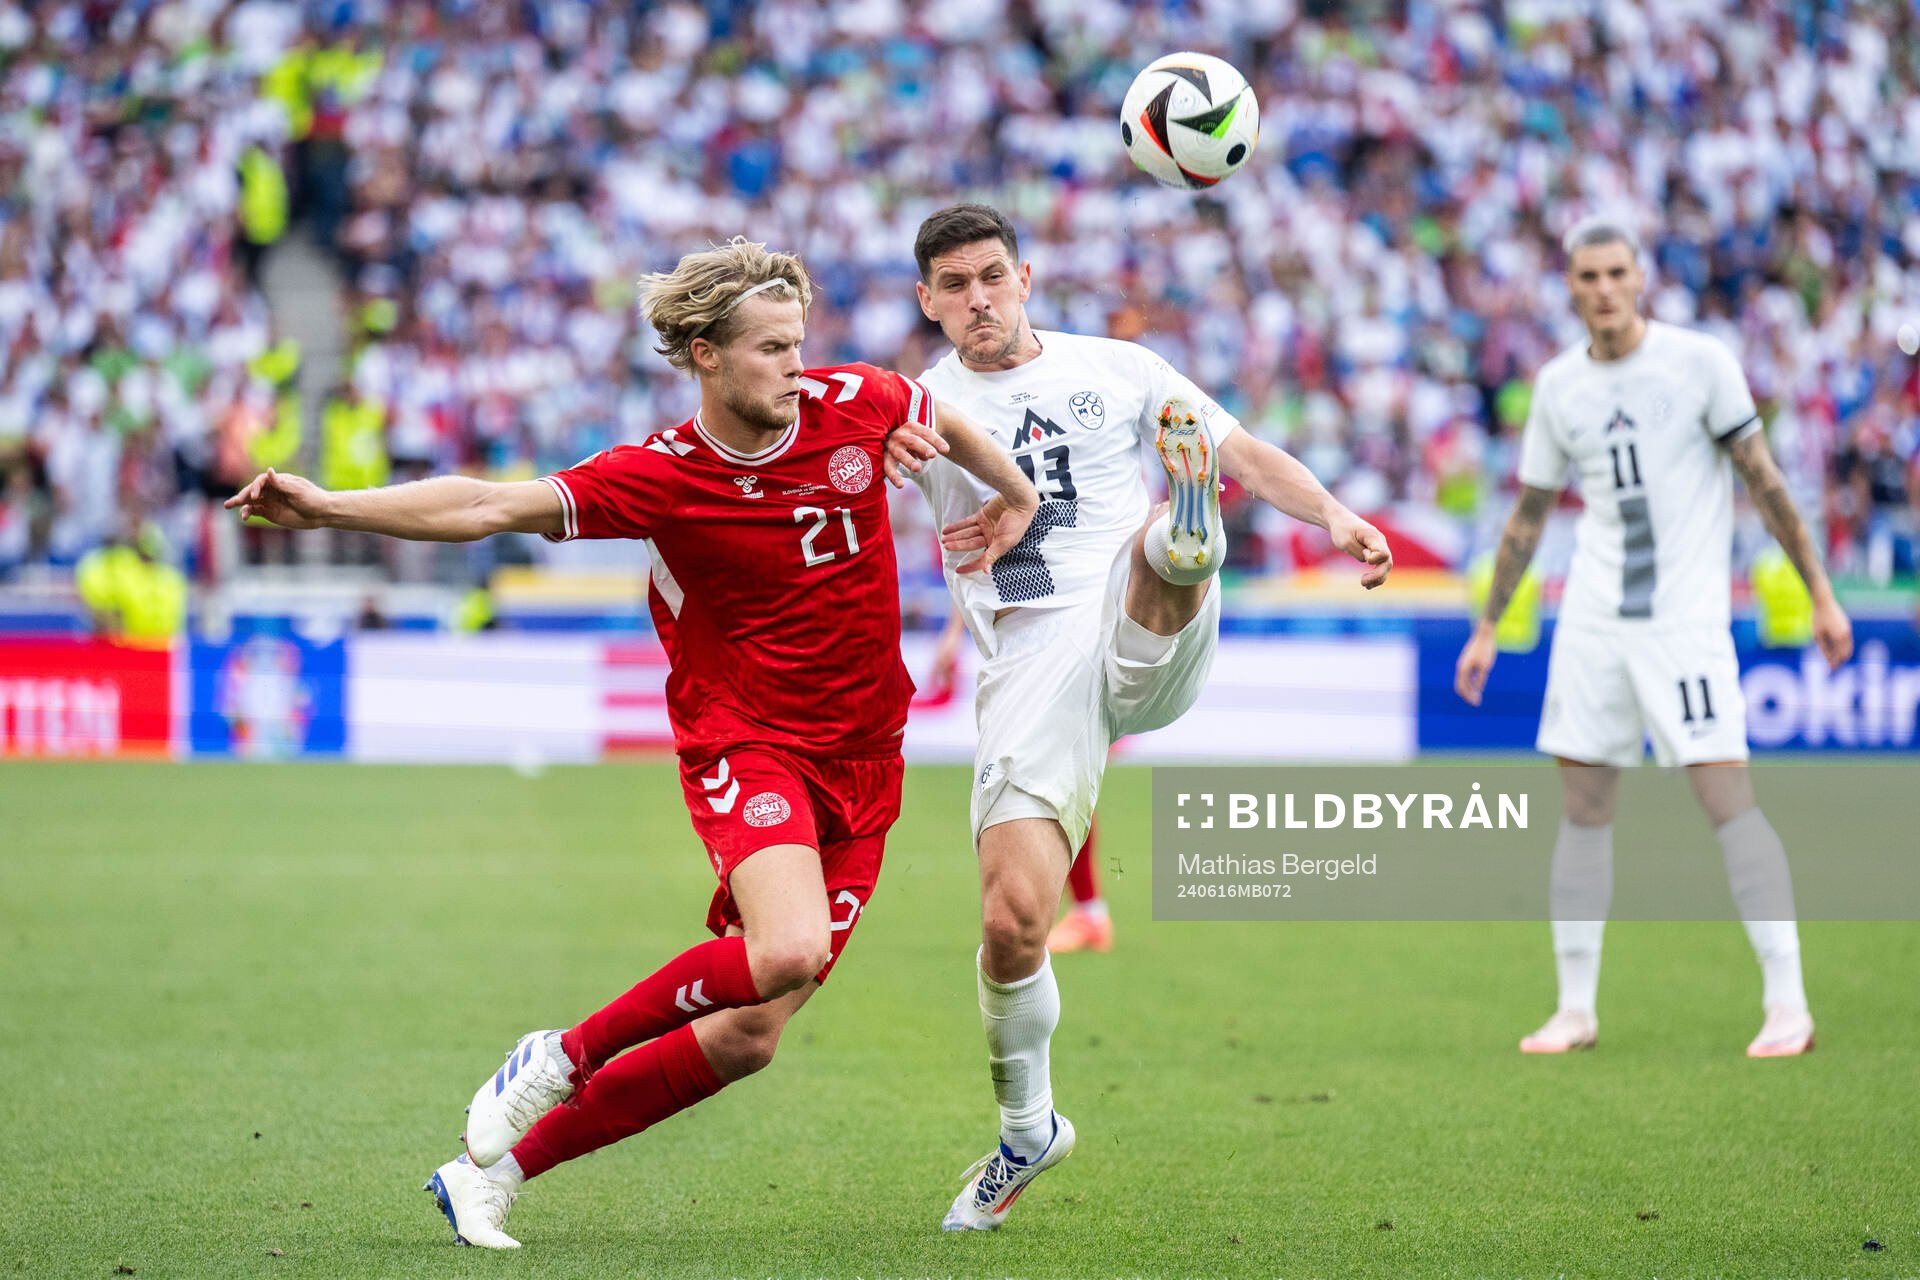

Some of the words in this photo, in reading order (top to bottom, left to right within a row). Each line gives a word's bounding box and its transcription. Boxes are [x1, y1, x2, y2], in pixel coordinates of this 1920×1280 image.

[837, 456, 865, 482] DBU
[1609, 443, 1643, 489] 11
[793, 506, 860, 568] 21
[1678, 677, 1717, 722] 11
[752, 802, 782, 818] DBU
